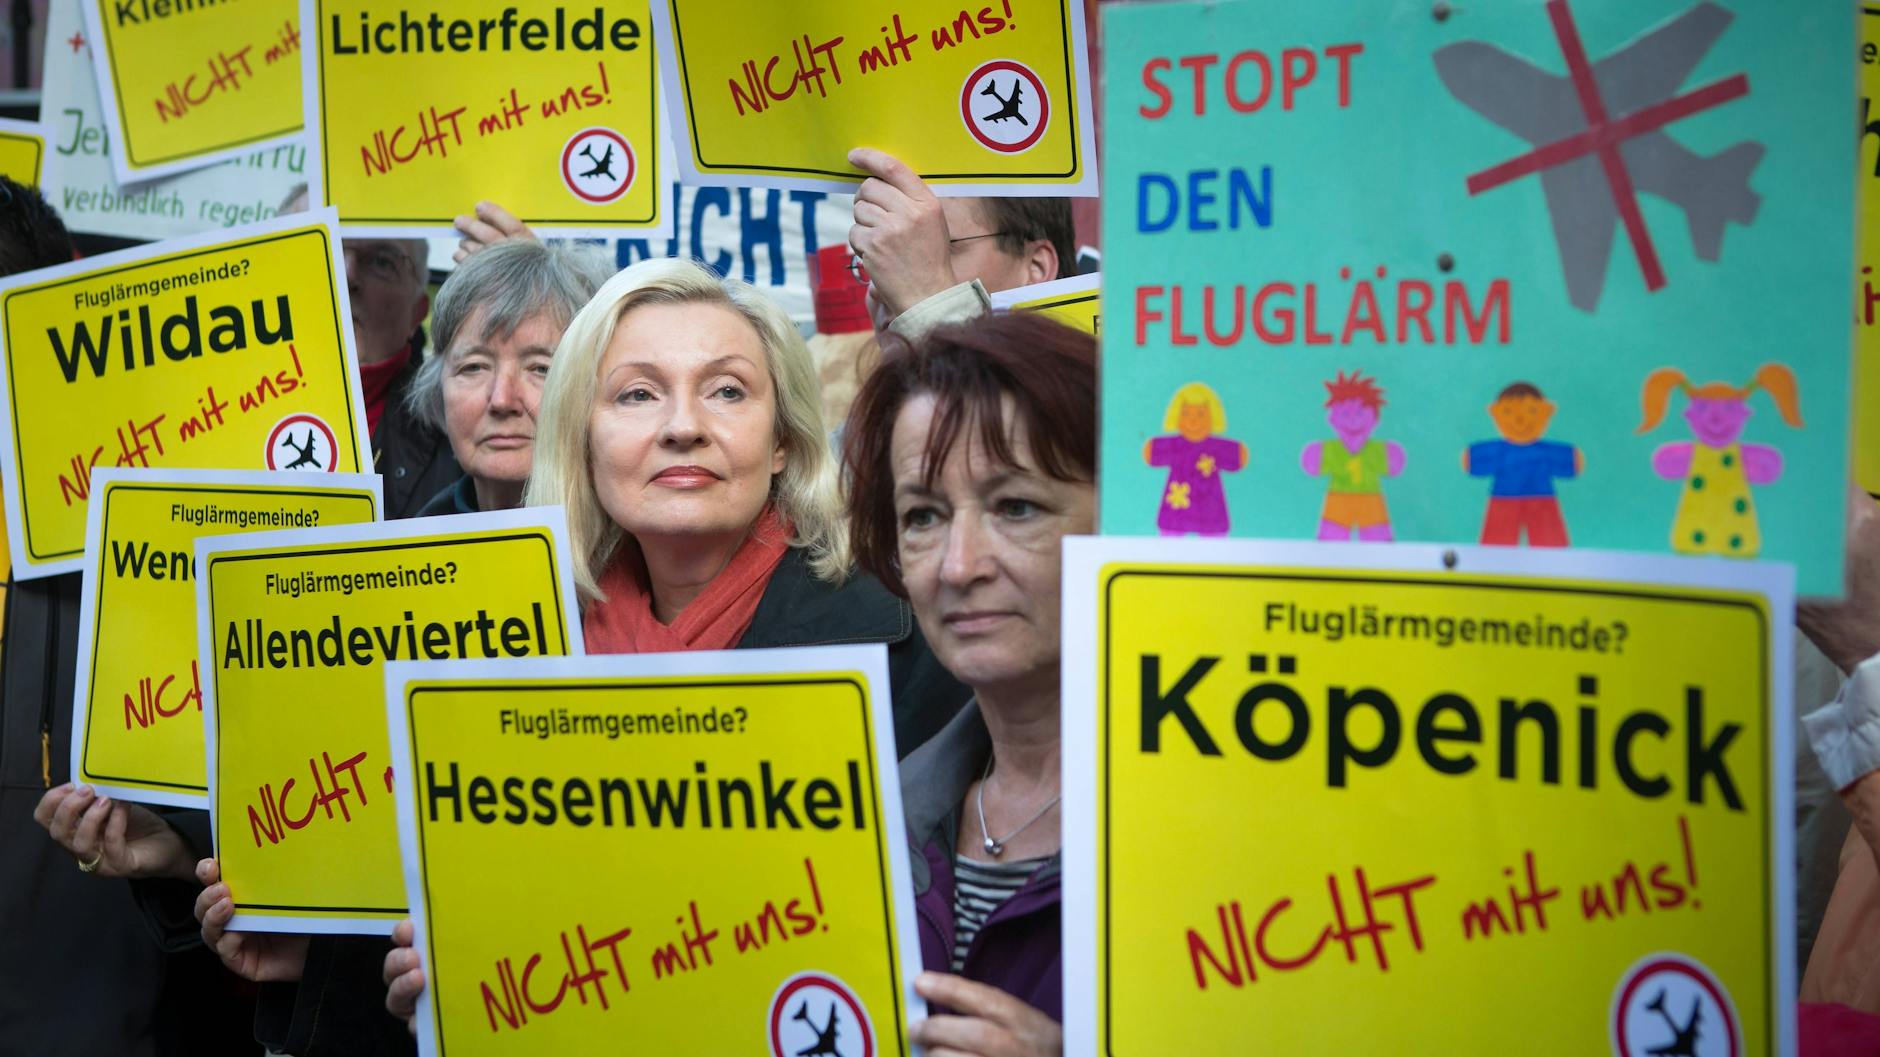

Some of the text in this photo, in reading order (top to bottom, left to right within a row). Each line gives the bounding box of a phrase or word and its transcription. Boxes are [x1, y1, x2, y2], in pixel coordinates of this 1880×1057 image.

[333, 8, 639, 54] Lichterfelde
[728, 0, 1016, 115] NICHT mit uns!
[153, 25, 301, 122] NICHT mit
[1140, 45, 1362, 118] STOPT
[361, 107, 465, 176] NICHT
[479, 88, 529, 136] mit
[541, 63, 611, 118] uns!
[1137, 165, 1273, 234] DEN
[75, 259, 251, 312] Fluglärmgemeinde?
[1136, 267, 1509, 346] FLUGLÄRM
[47, 294, 294, 384] Wildau
[179, 385, 229, 440] mit
[239, 344, 306, 412] uns!
[172, 505, 318, 527] Fluglärmgemeinde?
[267, 562, 456, 597] Fluglärmgemeinde?
[224, 603, 547, 668] Allendeviertel
[1264, 603, 1629, 653] Fluglärmgemeinde?
[501, 708, 746, 738] Fluglärmgemeinde?
[1142, 656, 1746, 812] Köpenick
[248, 752, 367, 847] NICHT
[426, 762, 864, 829] Hessenwinkel
[1186, 818, 1701, 990] NICHT mit uns!
[480, 859, 828, 1031] NICHT mit uns!
